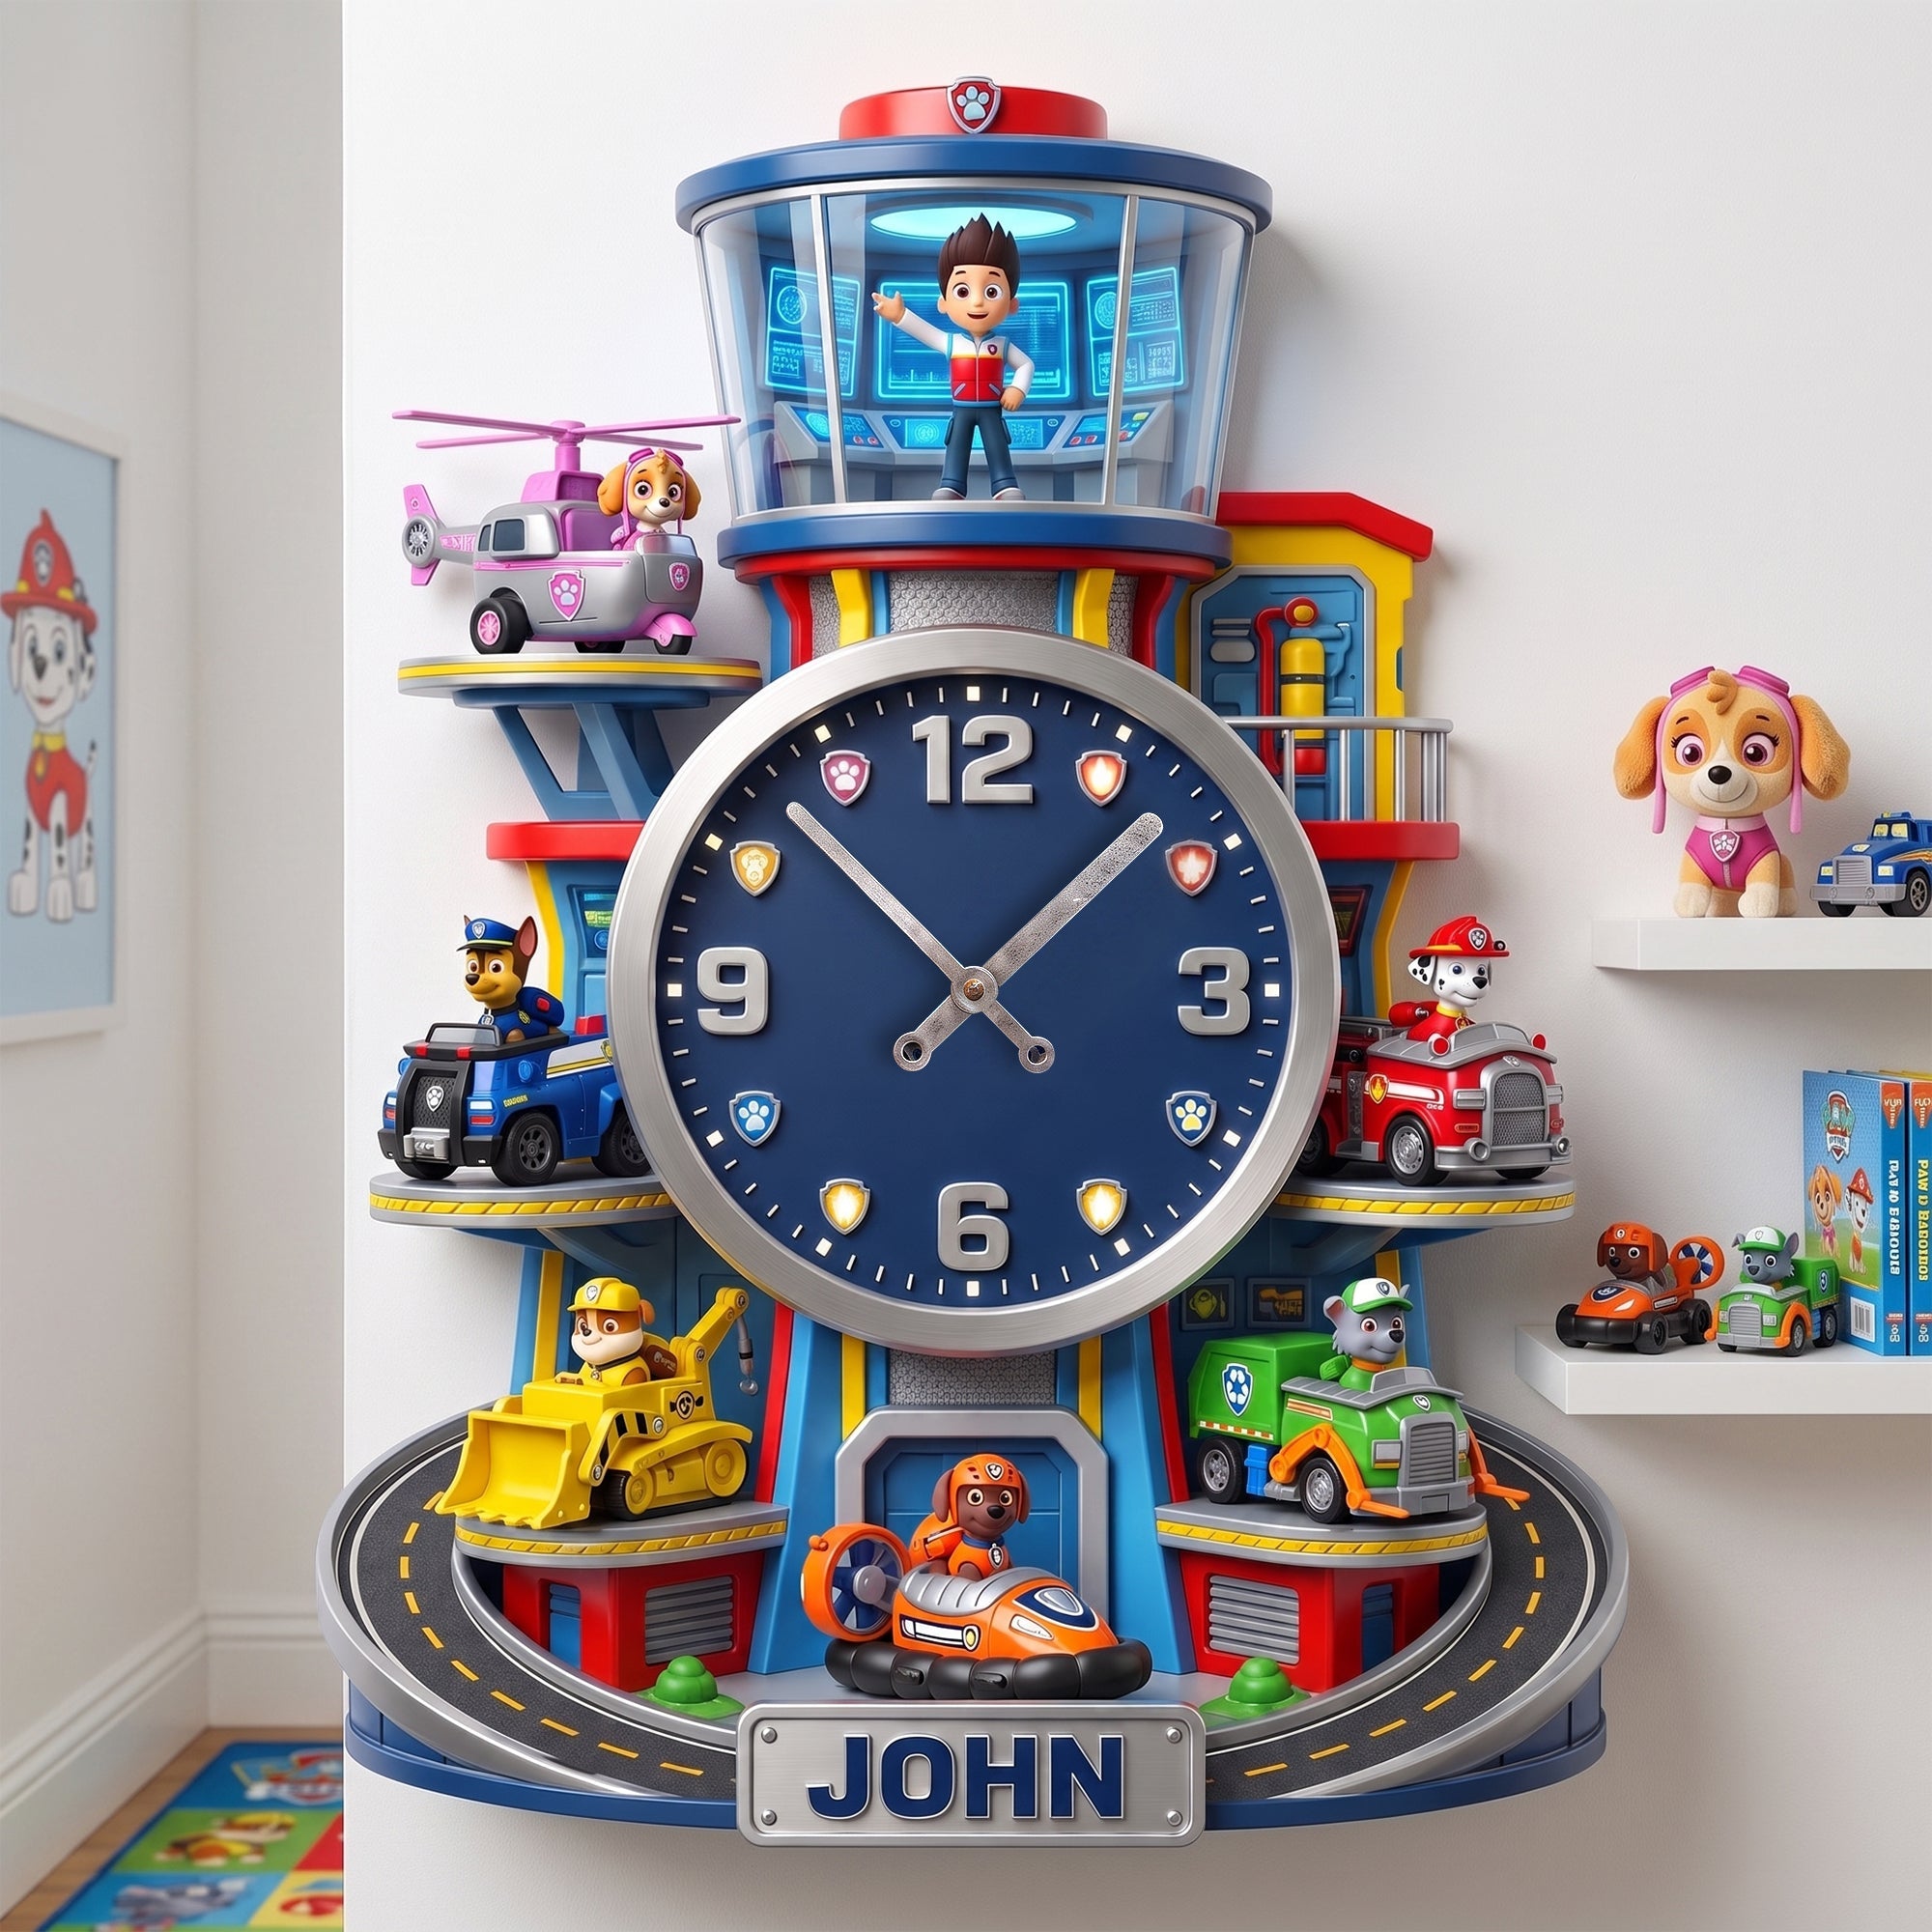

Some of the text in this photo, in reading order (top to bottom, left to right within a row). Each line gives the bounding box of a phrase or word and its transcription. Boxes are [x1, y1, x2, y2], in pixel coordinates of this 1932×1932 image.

[911, 715, 1034, 804] 12
[696, 947, 769, 1036] 9
[1178, 947, 1251, 1036] 3
[937, 1181, 1009, 1270] 6
[805, 1733, 1124, 1820] JOHN
